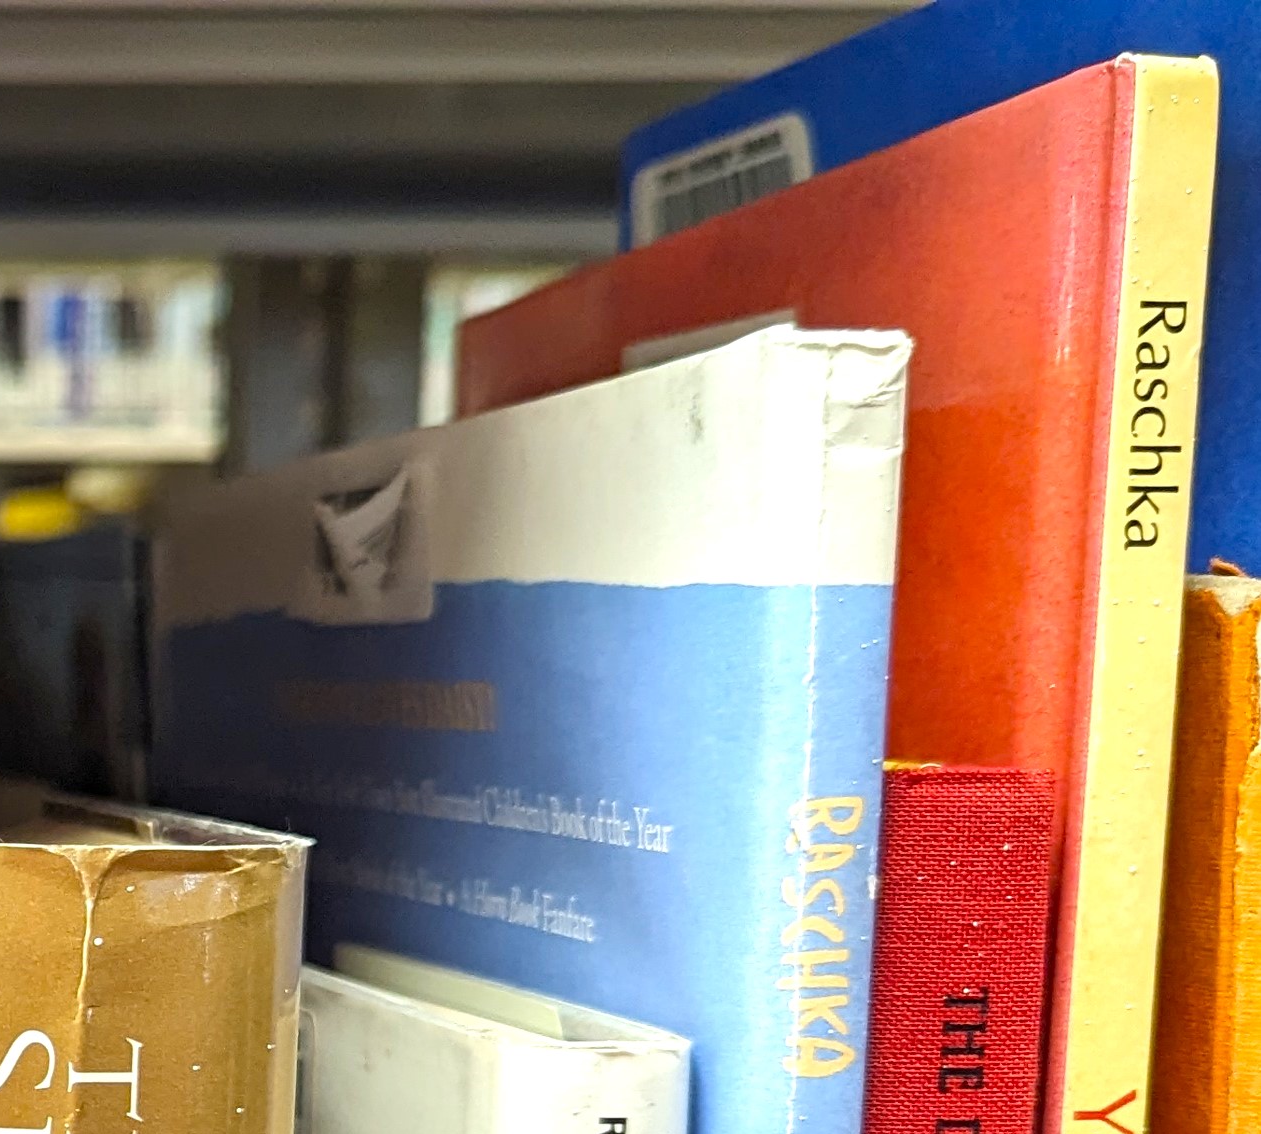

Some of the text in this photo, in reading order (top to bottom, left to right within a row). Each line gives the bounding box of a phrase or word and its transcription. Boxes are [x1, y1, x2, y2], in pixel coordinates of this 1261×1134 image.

[1123, 300, 1188, 551] Raschka
[633, 806, 674, 854] Year
[777, 795, 863, 1079] RASCHKA
[940, 986, 989, 1095] THE
